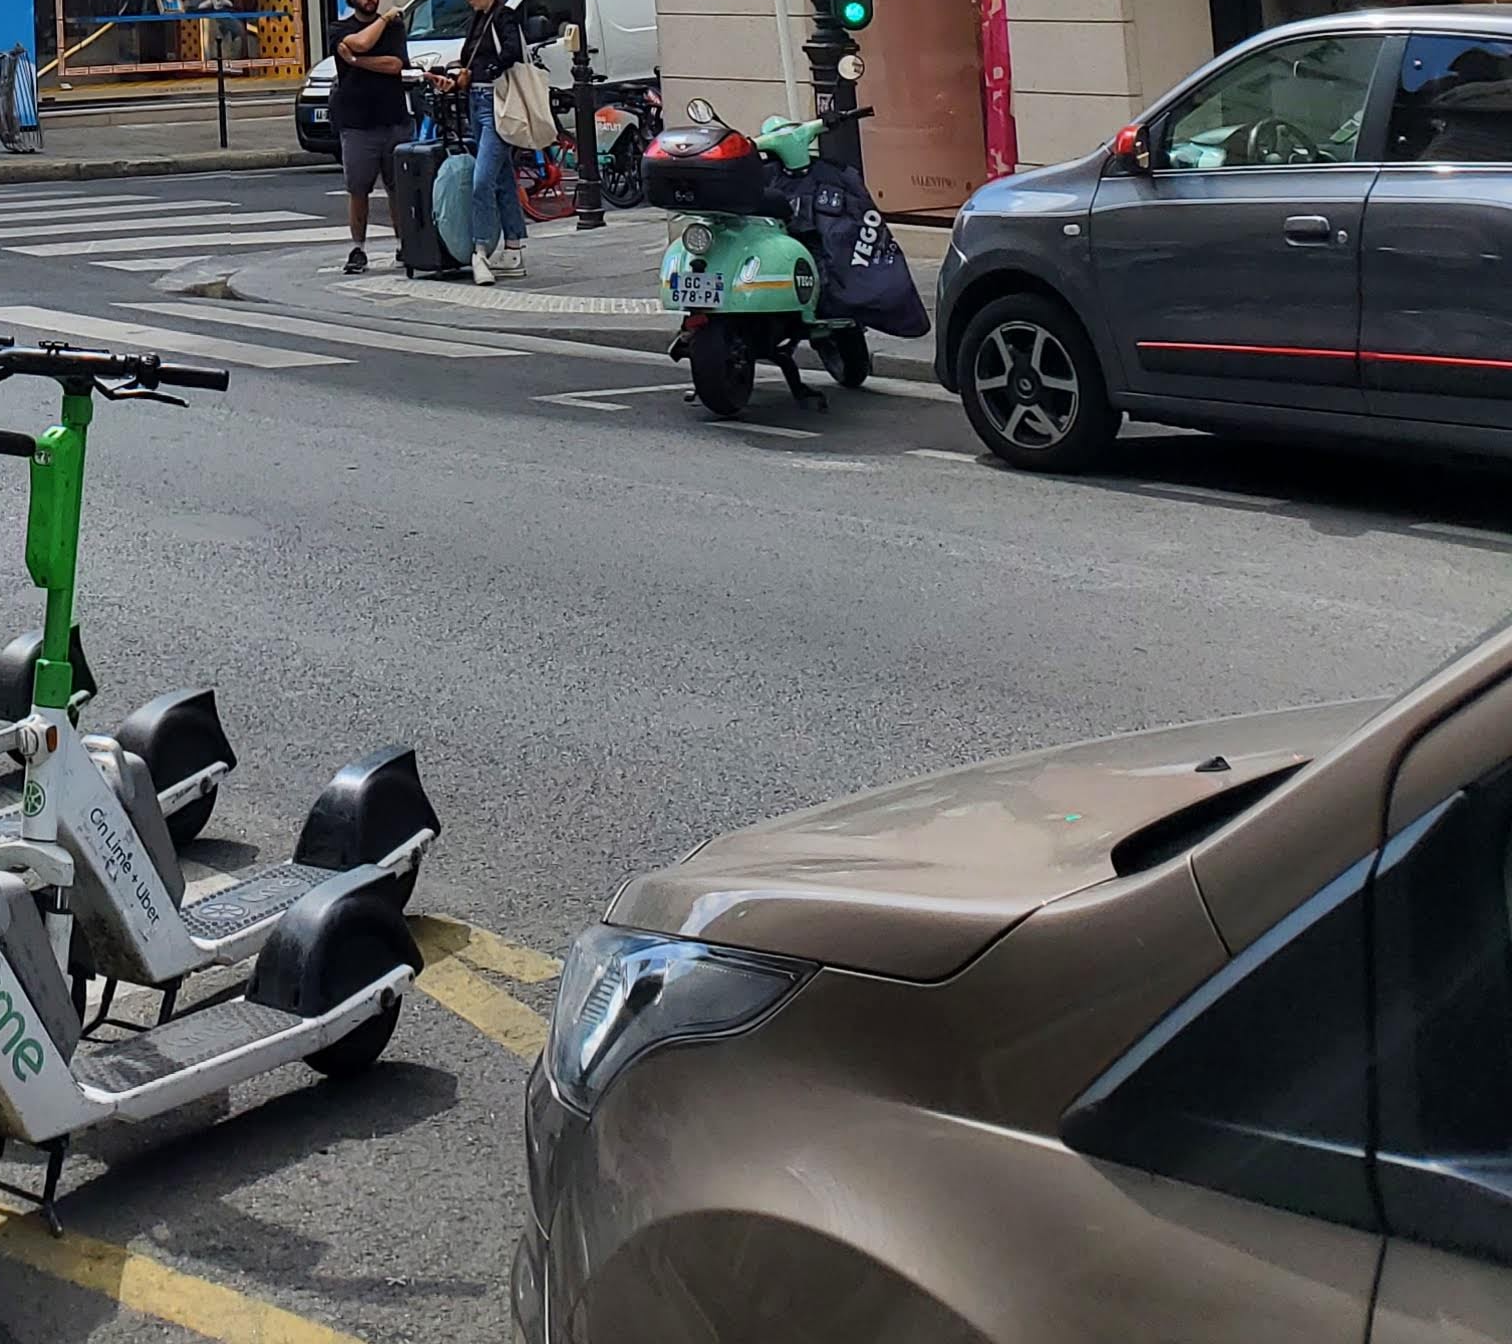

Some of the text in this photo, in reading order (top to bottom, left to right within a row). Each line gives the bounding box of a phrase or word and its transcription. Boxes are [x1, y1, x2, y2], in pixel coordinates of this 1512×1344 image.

[851, 209, 882, 267] YEGO
[105, 830, 132, 874] Lime
[136, 881, 161, 925] Uber
